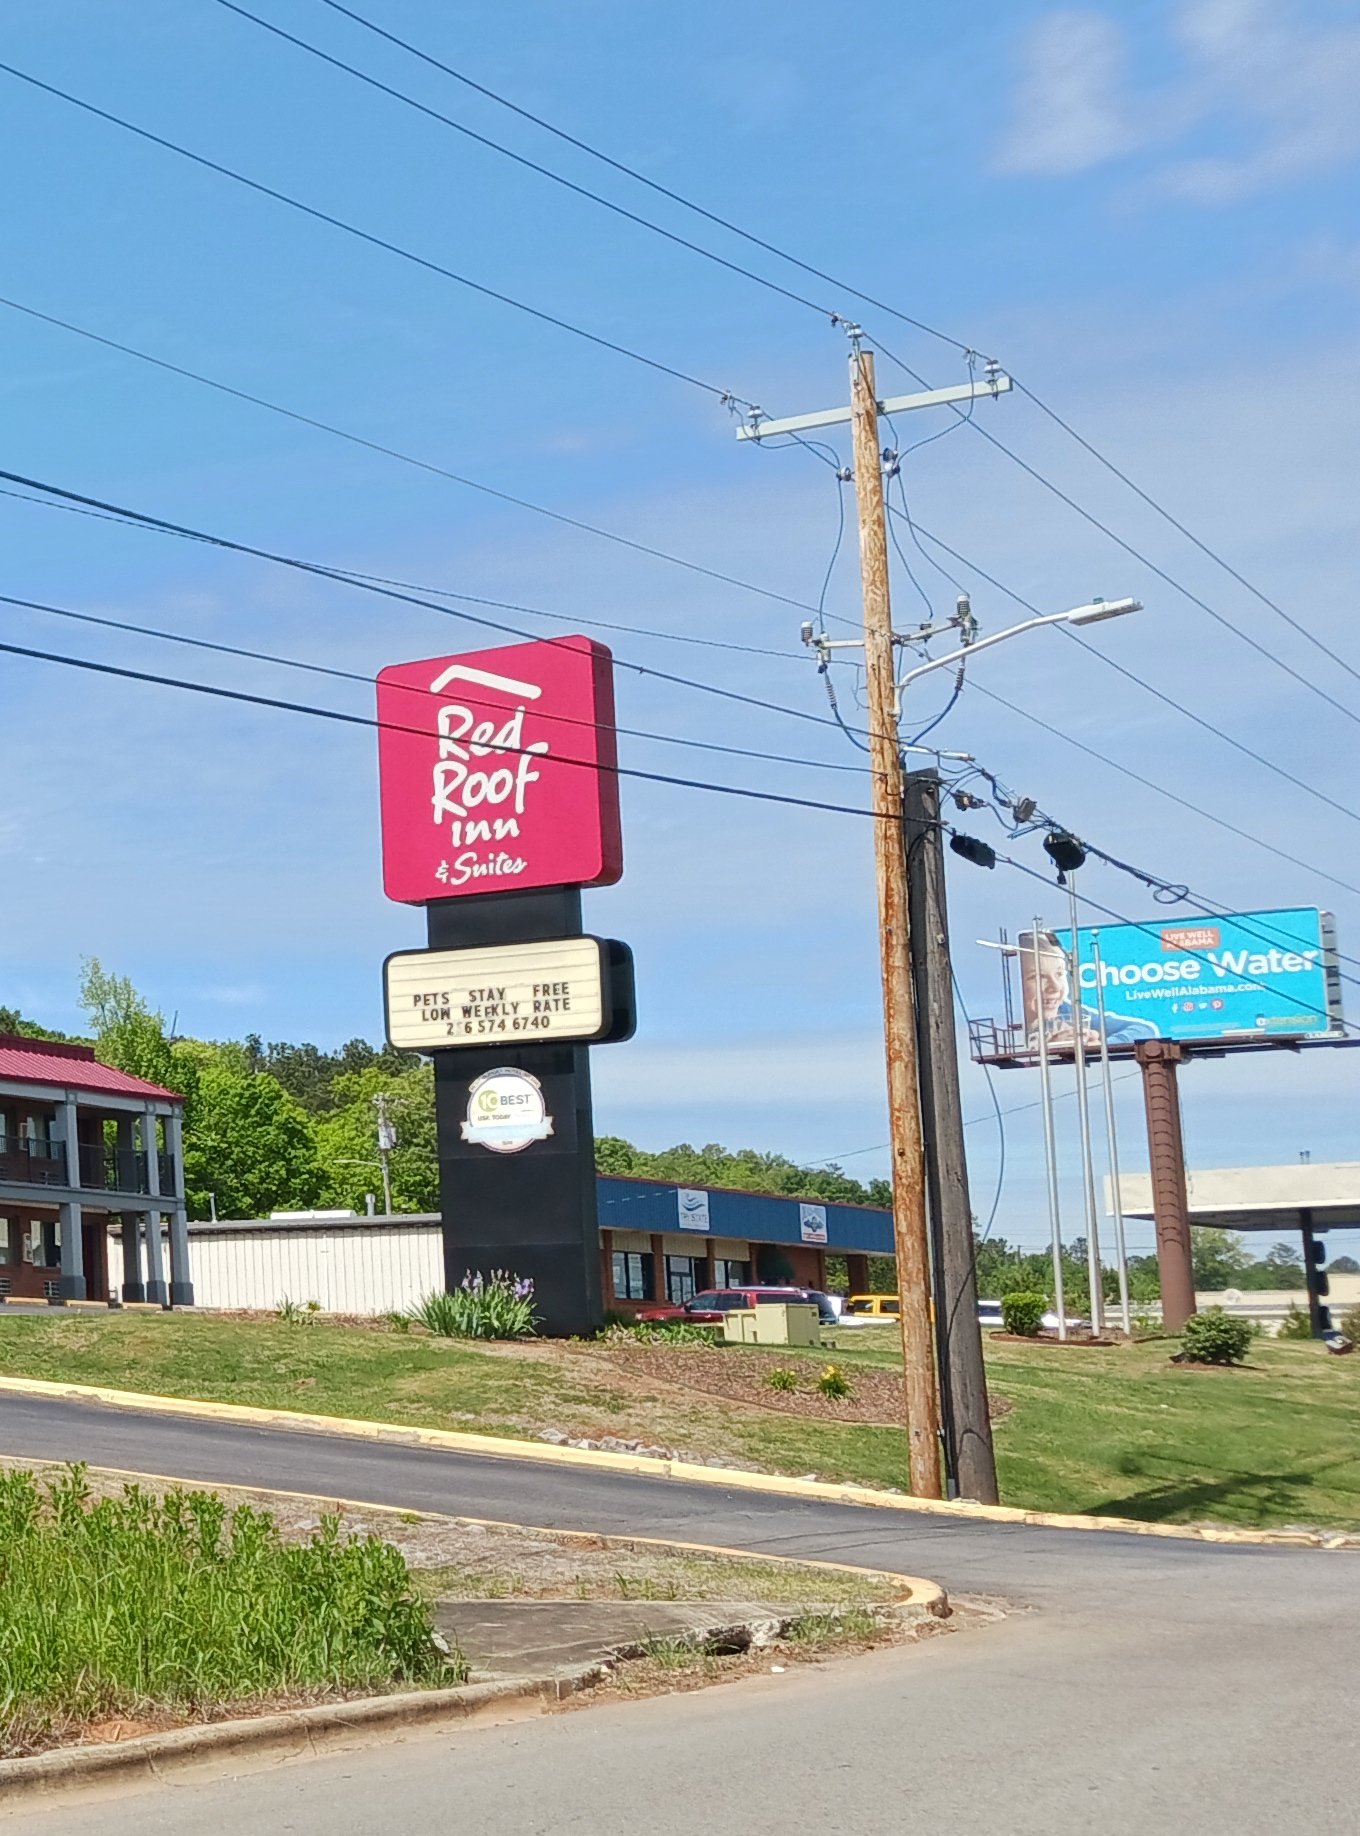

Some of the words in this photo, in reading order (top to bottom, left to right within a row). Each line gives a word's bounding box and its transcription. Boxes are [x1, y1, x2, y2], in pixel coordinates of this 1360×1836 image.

[437, 704, 526, 761] Red
[431, 741, 549, 825] Roof
[434, 859, 450, 884] &
[450, 851, 528, 887] Suites
[1186, 929, 1215, 939] WELL
[1079, 956, 1201, 989] Choose
[1207, 948, 1319, 978] Water
[413, 992, 450, 1007] PETS
[468, 987, 506, 1003] STAY
[532, 981, 570, 998] FREE
[1125, 981, 1266, 1001] LiveWellAlabama.com
[532, 997, 571, 1014] RATE
[477, 1018, 506, 1034] 574
[512, 1015, 551, 1031] 6740
